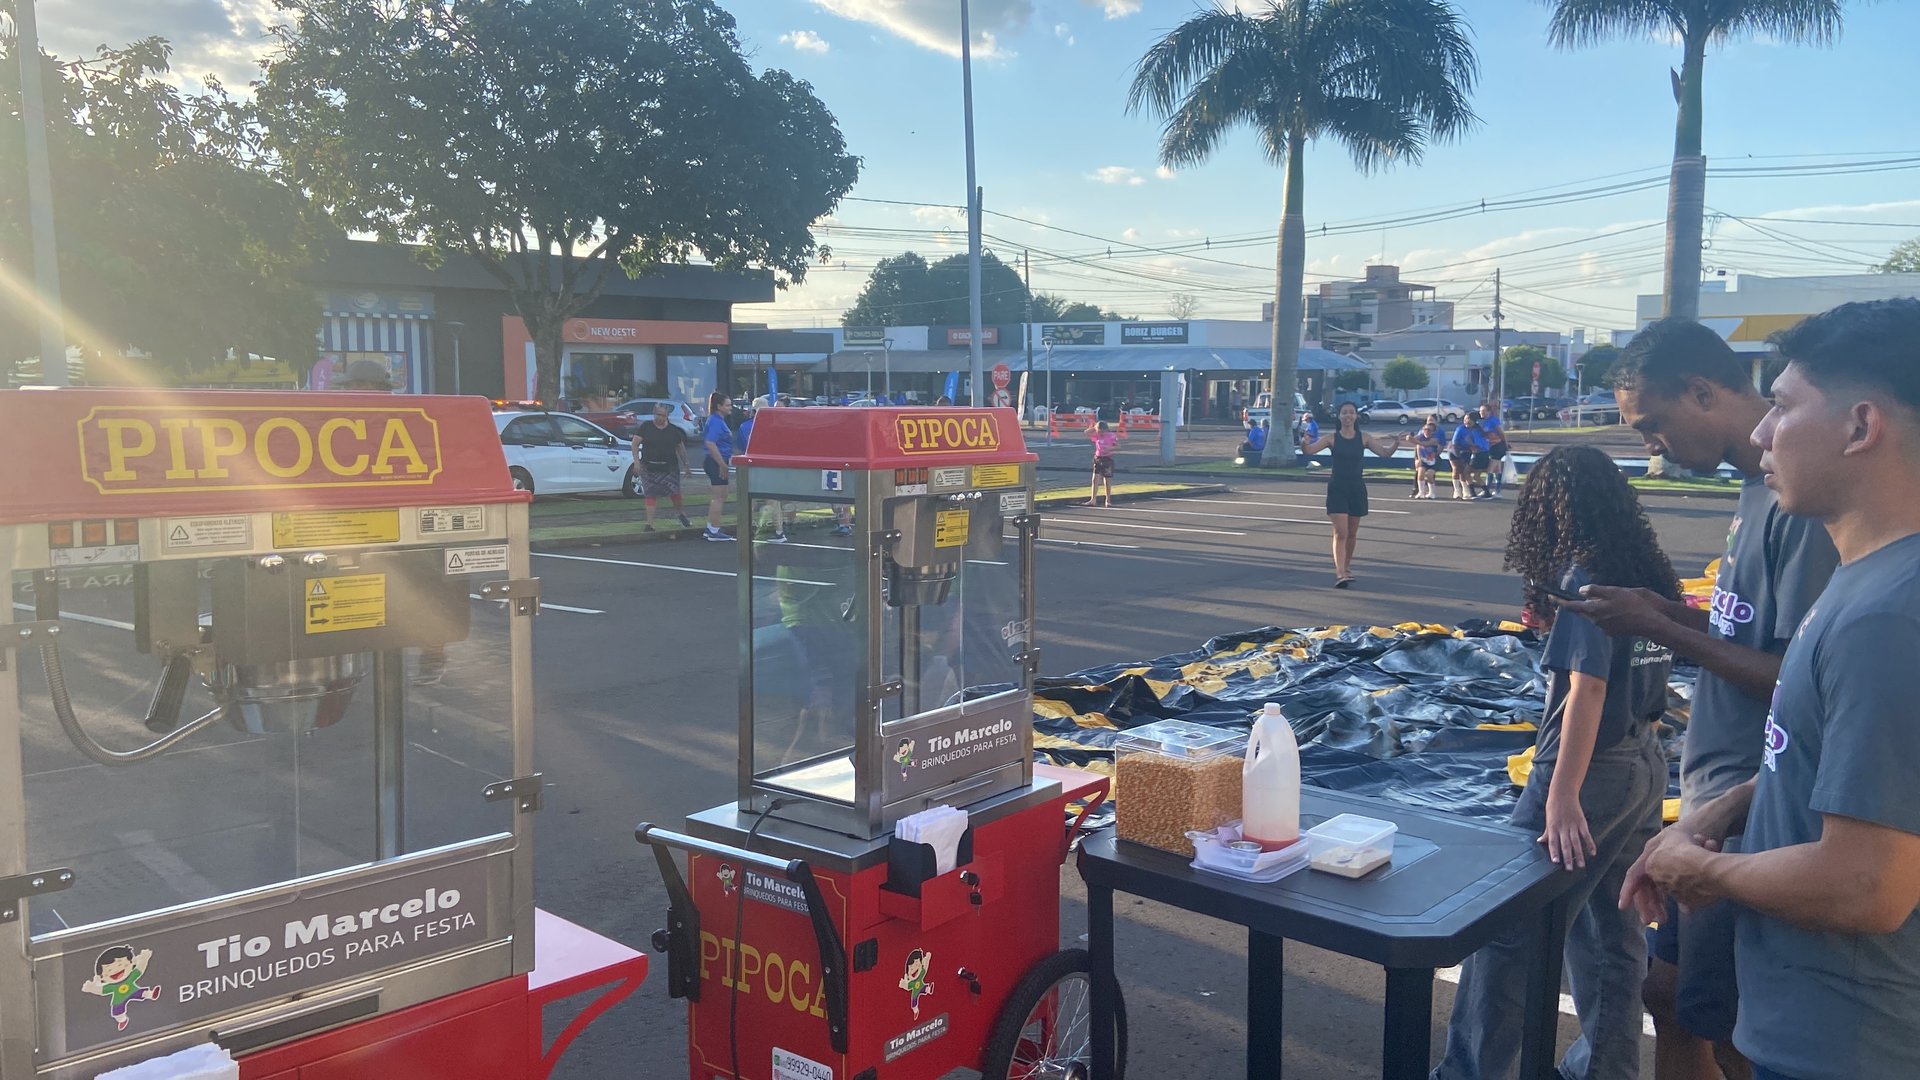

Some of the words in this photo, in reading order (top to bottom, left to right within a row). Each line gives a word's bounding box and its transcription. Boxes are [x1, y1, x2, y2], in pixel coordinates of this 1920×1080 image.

[591, 327, 610, 336] NEW
[612, 328, 636, 337] OESTE
[1125, 327, 1149, 336] RORIZ
[1151, 327, 1183, 336] BURGER
[993, 370, 1010, 381] PARE
[98, 417, 428, 481] PIPOCA
[900, 418, 996, 449] PIPOCA
[921, 746, 971, 770] BRINQUEDOS
[973, 739, 993, 754] PARA
[995, 733, 1017, 748] FESTA
[928, 734, 951, 753] Tio
[954, 719, 1012, 745] Marcelo
[746, 872, 762, 887] Tio
[777, 896, 793, 908] PARA
[197, 933, 271, 969] Tio
[284, 886, 462, 949] Marcelo
[178, 947, 336, 1004] BRINQUEDOS
[345, 930, 405, 960] PARA
[414, 912, 476, 943] FESTA
[889, 1037, 905, 1050] Tio
[906, 1018, 943, 1041] Marcelo
